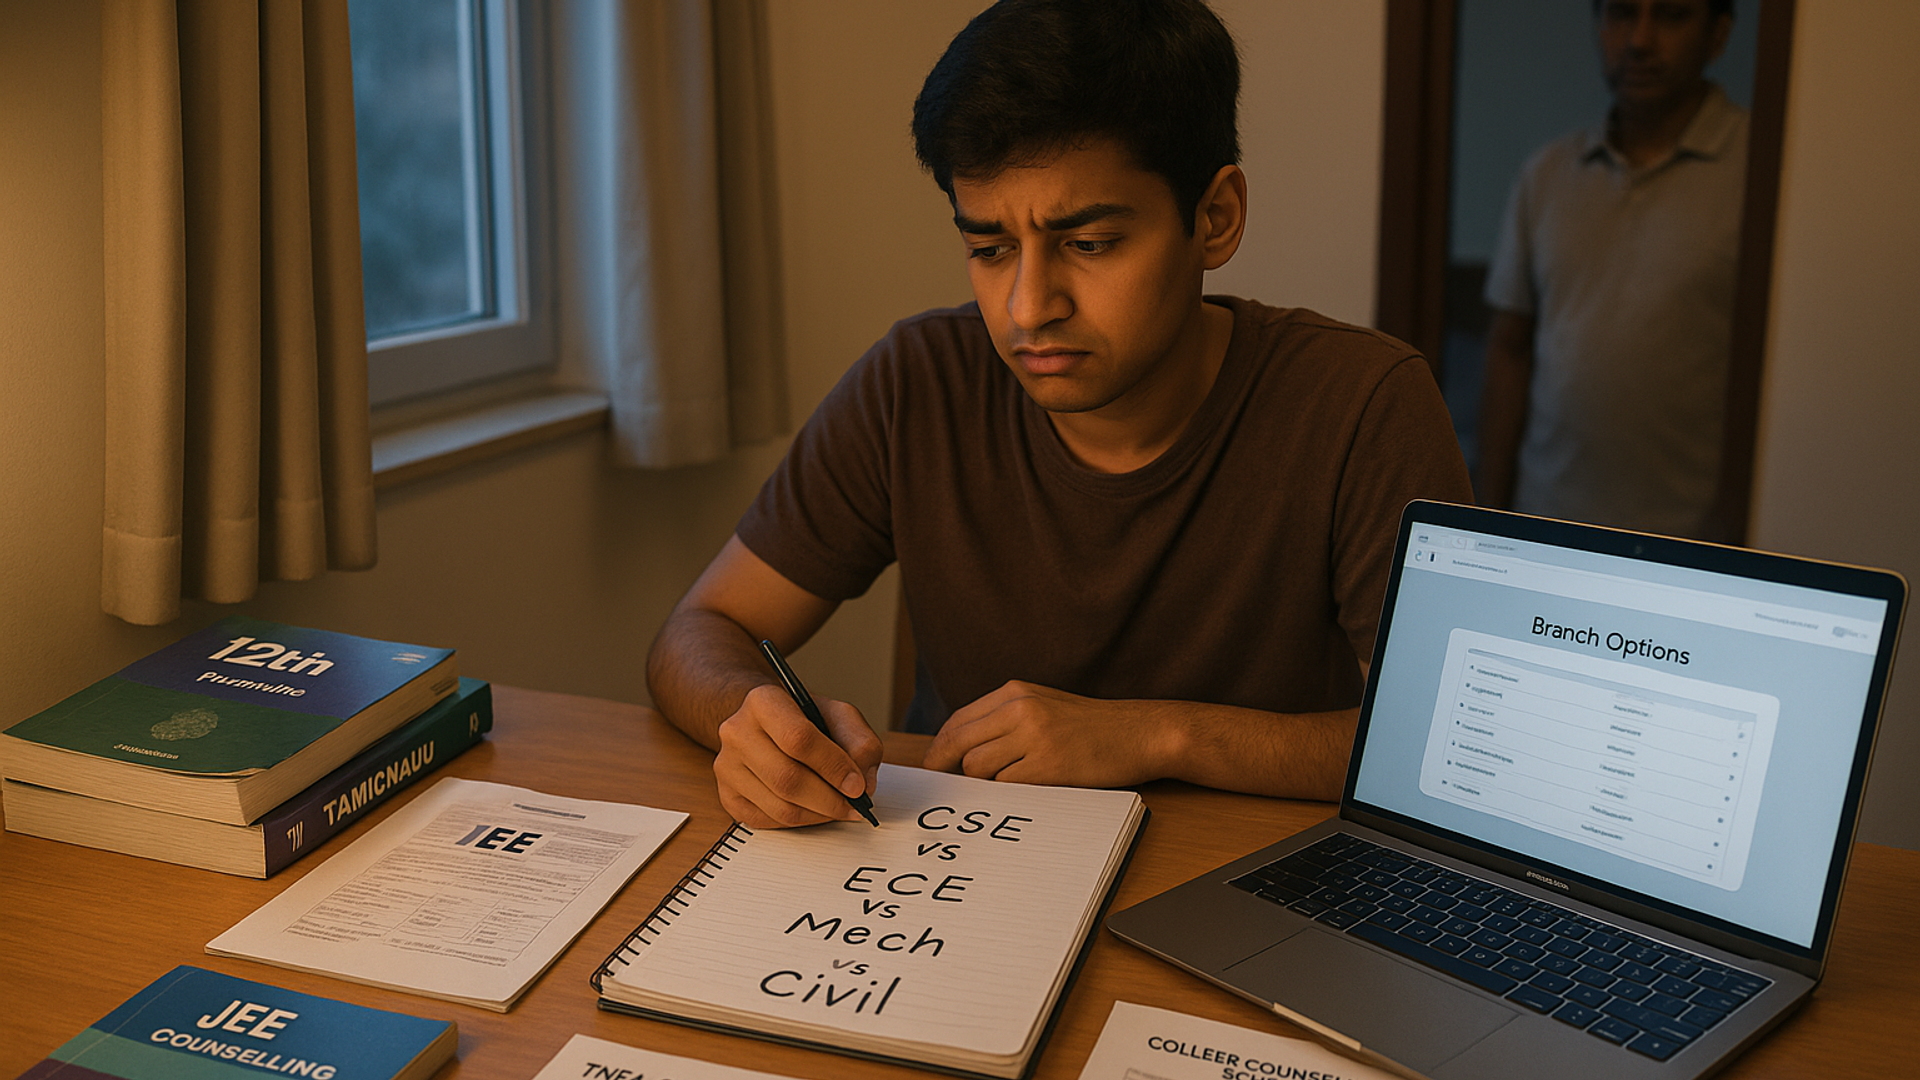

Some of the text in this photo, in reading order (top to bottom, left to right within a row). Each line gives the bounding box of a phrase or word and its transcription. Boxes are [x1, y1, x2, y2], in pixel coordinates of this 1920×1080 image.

[1531, 615, 1692, 667] Branch Options
[322, 740, 435, 826] TAMICNAUU
[917, 805, 1034, 842] CSE
[917, 842, 962, 862] vs
[843, 866, 974, 903] ECE
[863, 898, 901, 919] vs
[784, 911, 945, 957] Mech
[832, 958, 871, 976] vs
[760, 970, 902, 1015] Civil
[196, 1000, 299, 1040] JEE
[150, 1028, 337, 1080] COUNSELLING
[1148, 1036, 1240, 1067] COLLEER
